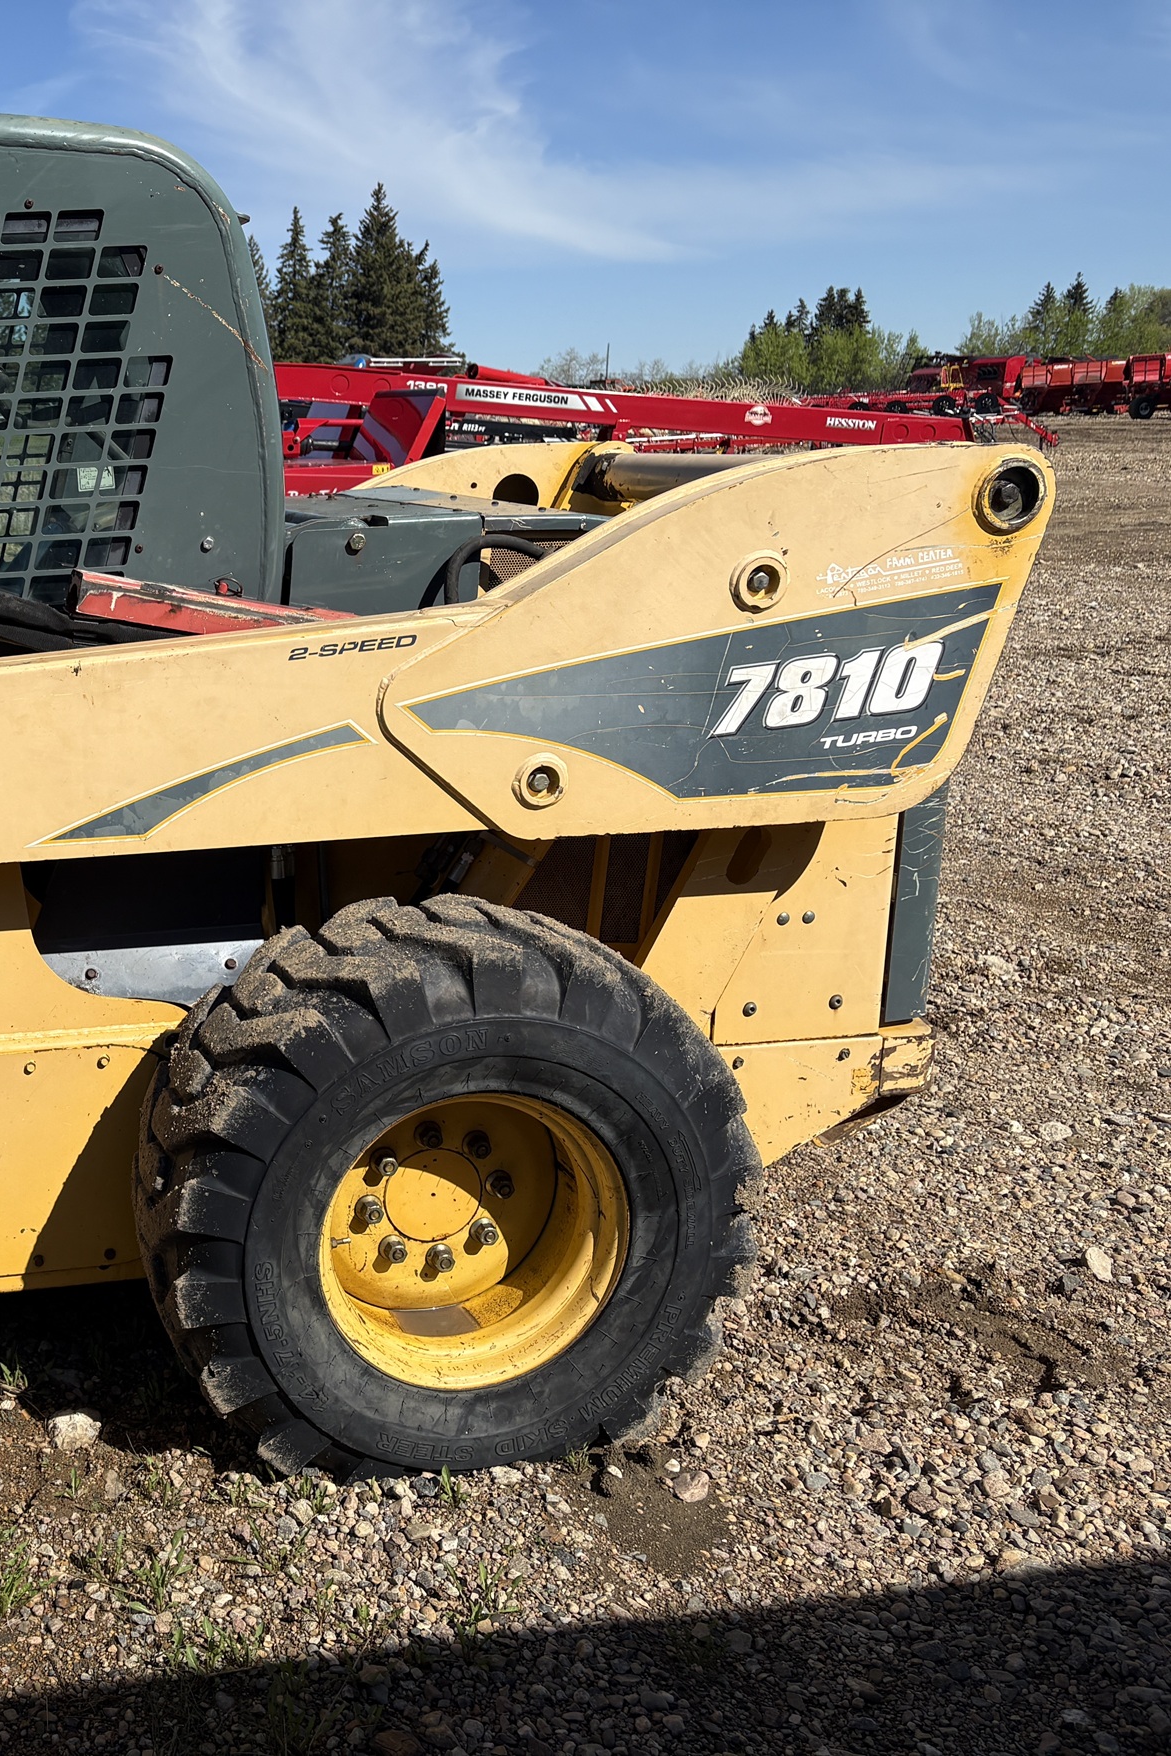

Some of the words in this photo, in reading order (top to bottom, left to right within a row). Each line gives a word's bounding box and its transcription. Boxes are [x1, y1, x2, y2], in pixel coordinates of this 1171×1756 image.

[465, 387, 509, 400] MASSEY
[512, 391, 569, 405] FERGUSON
[825, 416, 877, 430] HESSTON
[856, 575, 891, 588] WESTLOCK
[931, 566, 944, 574] RED
[946, 563, 963, 571] DEER
[887, 555, 915, 568] FARM
[288, 634, 417, 661] 2-SPEED
[707, 639, 945, 739] 7810
[820, 726, 918, 749] TURBO
[331, 1028, 489, 1116] SAMSON
[635, 1091, 670, 1130] HEAVY
[667, 1137, 689, 1173] DUTY
[683, 1177, 696, 1249] SIDEWALL
[579, 1303, 683, 1422] PREMIUM
[376, 1431, 475, 1462] STEER
[494, 1418, 569, 1457] SKID
